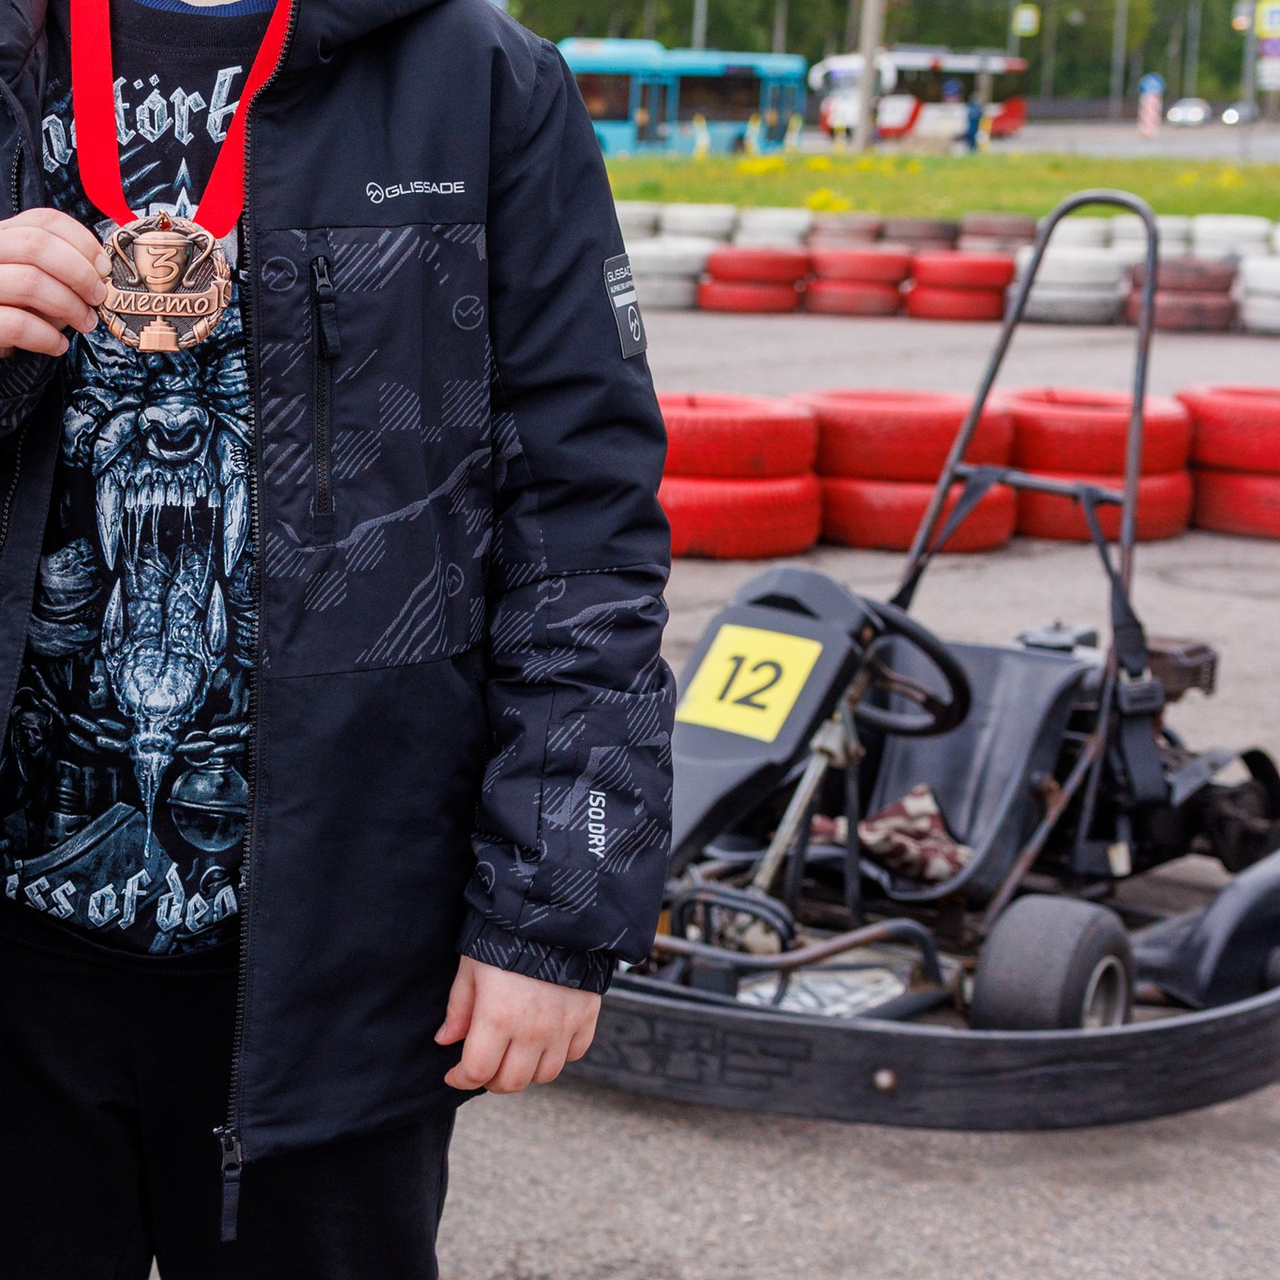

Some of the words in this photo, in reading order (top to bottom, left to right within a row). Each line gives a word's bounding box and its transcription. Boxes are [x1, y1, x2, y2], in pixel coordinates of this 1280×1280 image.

[384, 181, 466, 199] GLISSADE
[145, 246, 180, 285] 3
[607, 265, 632, 283] GLISSAD
[718, 655, 783, 710] 12
[87, 868, 152, 930] of
[156, 862, 246, 932] dea
